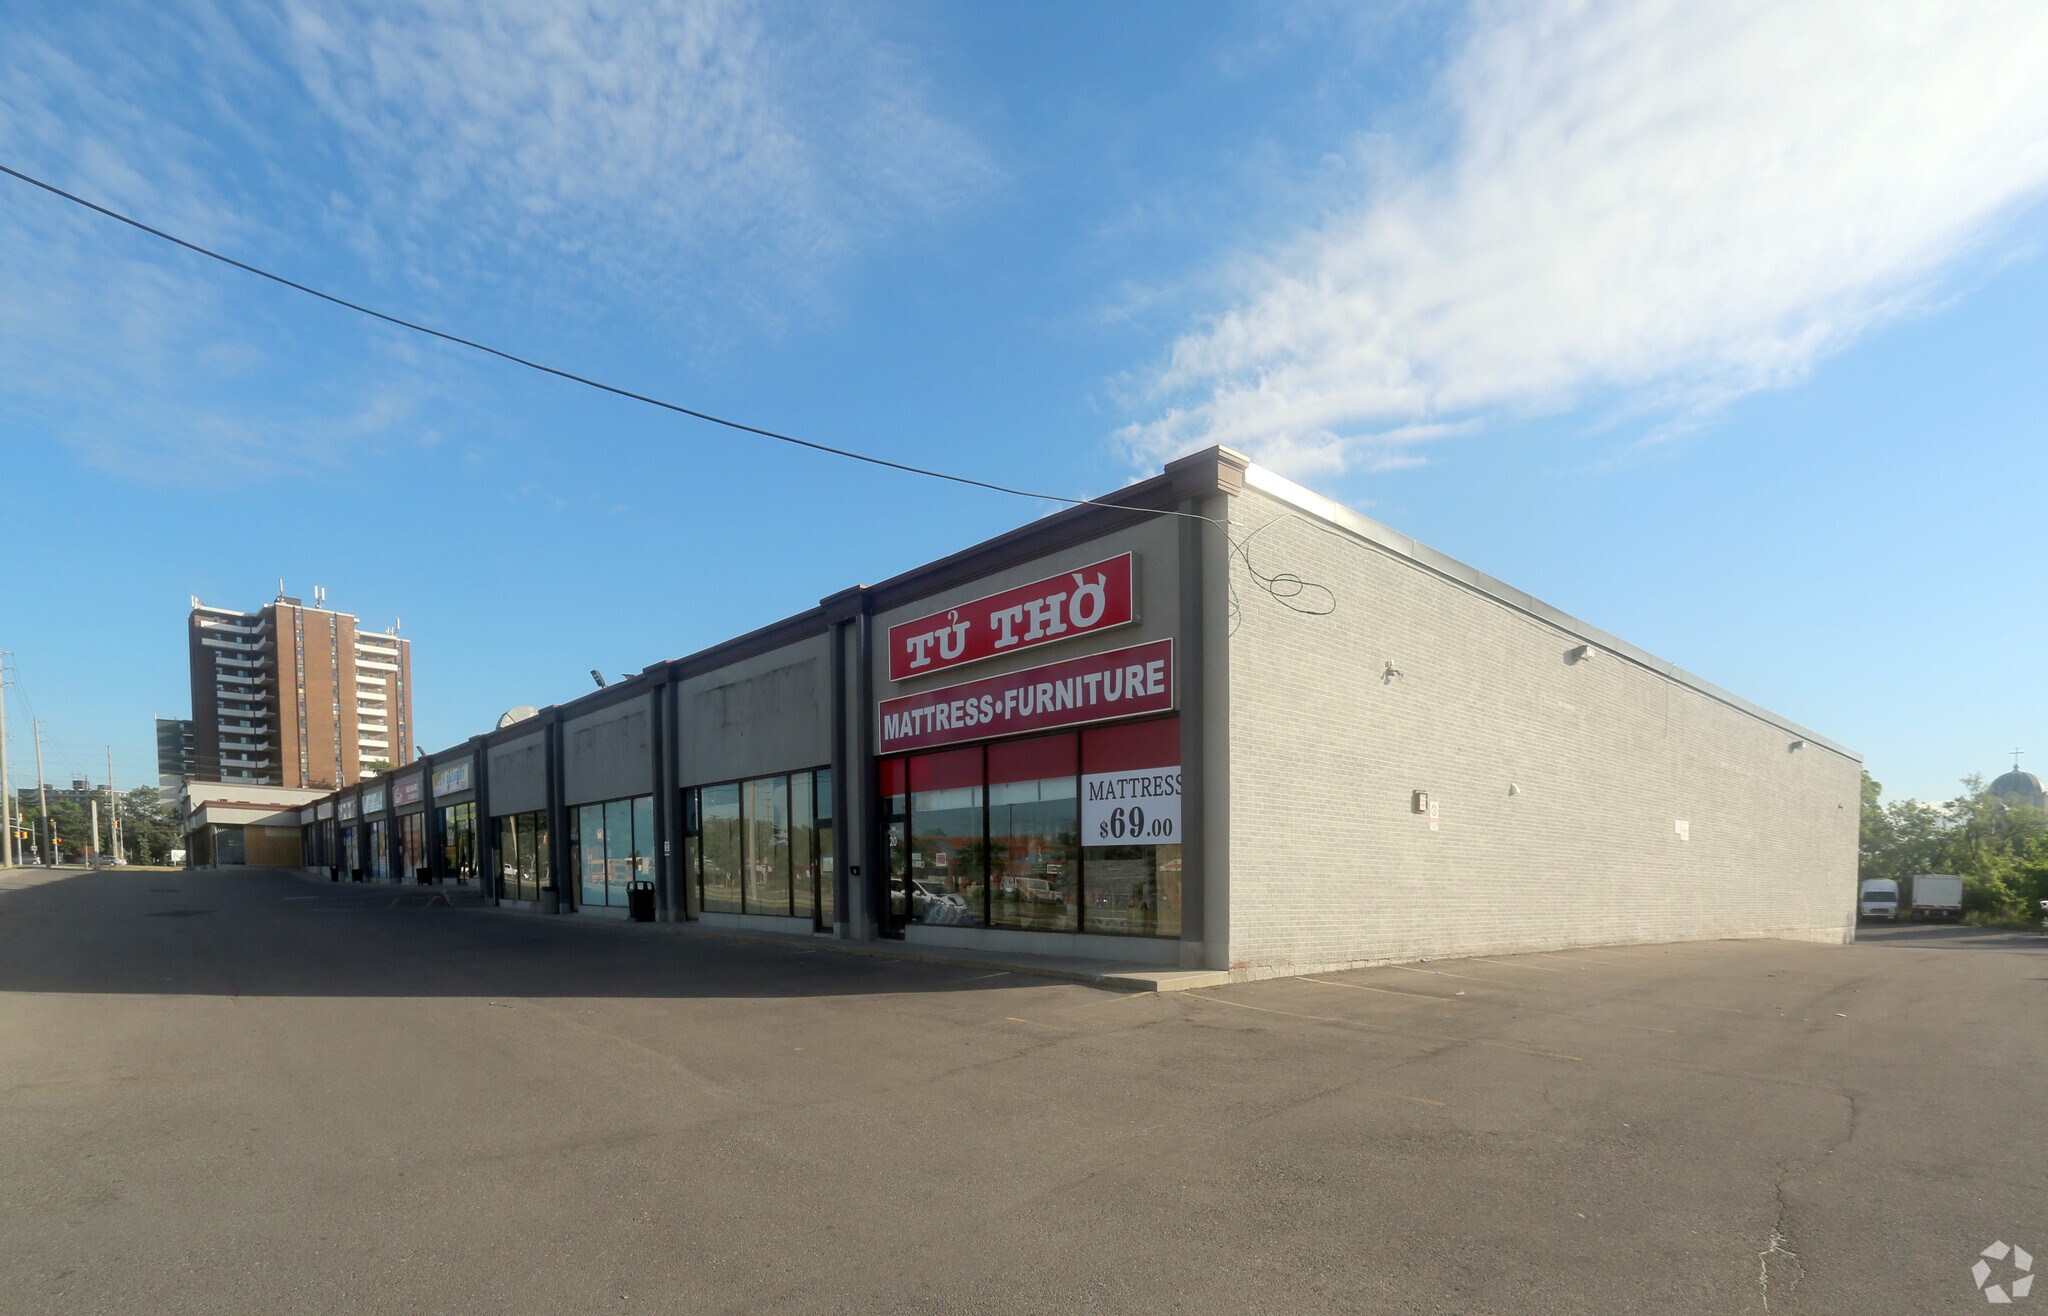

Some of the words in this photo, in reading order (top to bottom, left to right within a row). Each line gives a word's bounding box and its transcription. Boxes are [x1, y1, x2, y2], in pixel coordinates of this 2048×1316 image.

[990, 571, 1107, 649] THỜ
[1099, 806, 1173, 840] $69.00
[889, 836, 898, 847] 20
